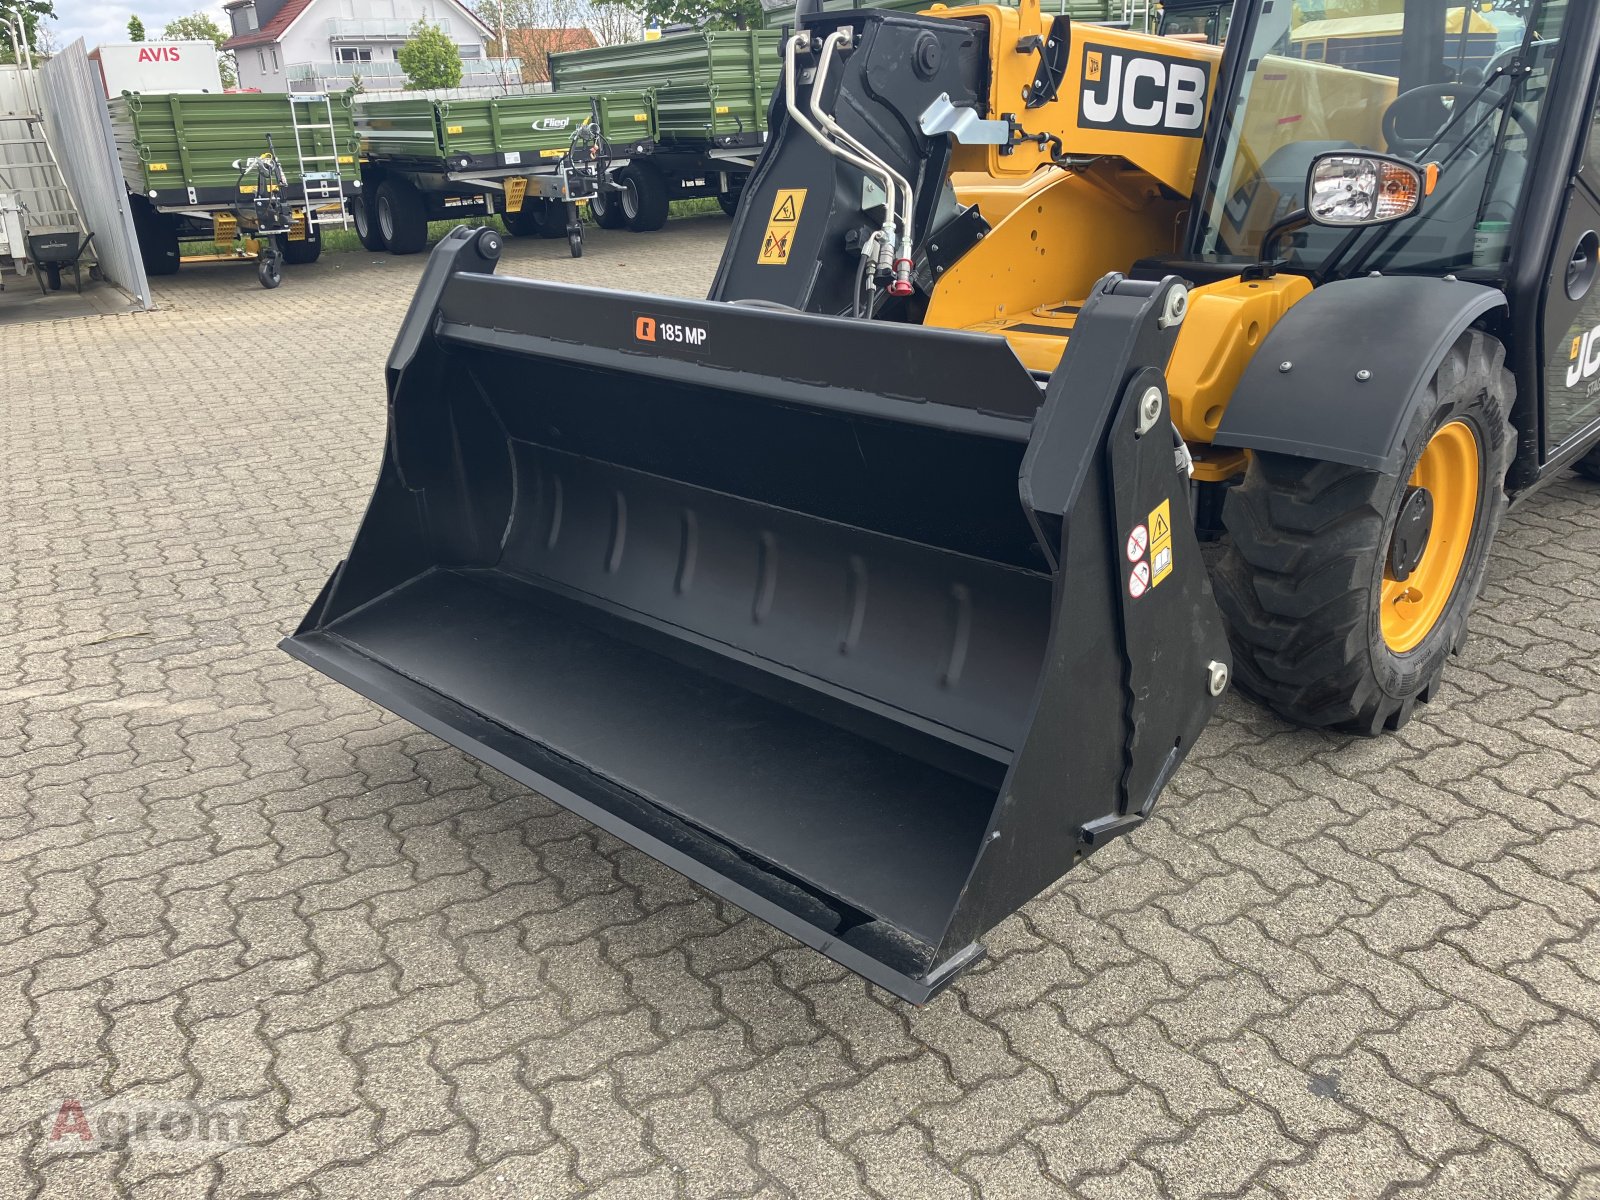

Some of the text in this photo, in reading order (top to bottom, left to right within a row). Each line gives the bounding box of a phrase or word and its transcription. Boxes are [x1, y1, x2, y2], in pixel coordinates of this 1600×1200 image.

[138, 47, 180, 62] AVIS
[1083, 55, 1206, 129] JCB
[543, 117, 570, 129] Fliegl
[660, 323, 683, 342] 185
[685, 326, 707, 346] MP
